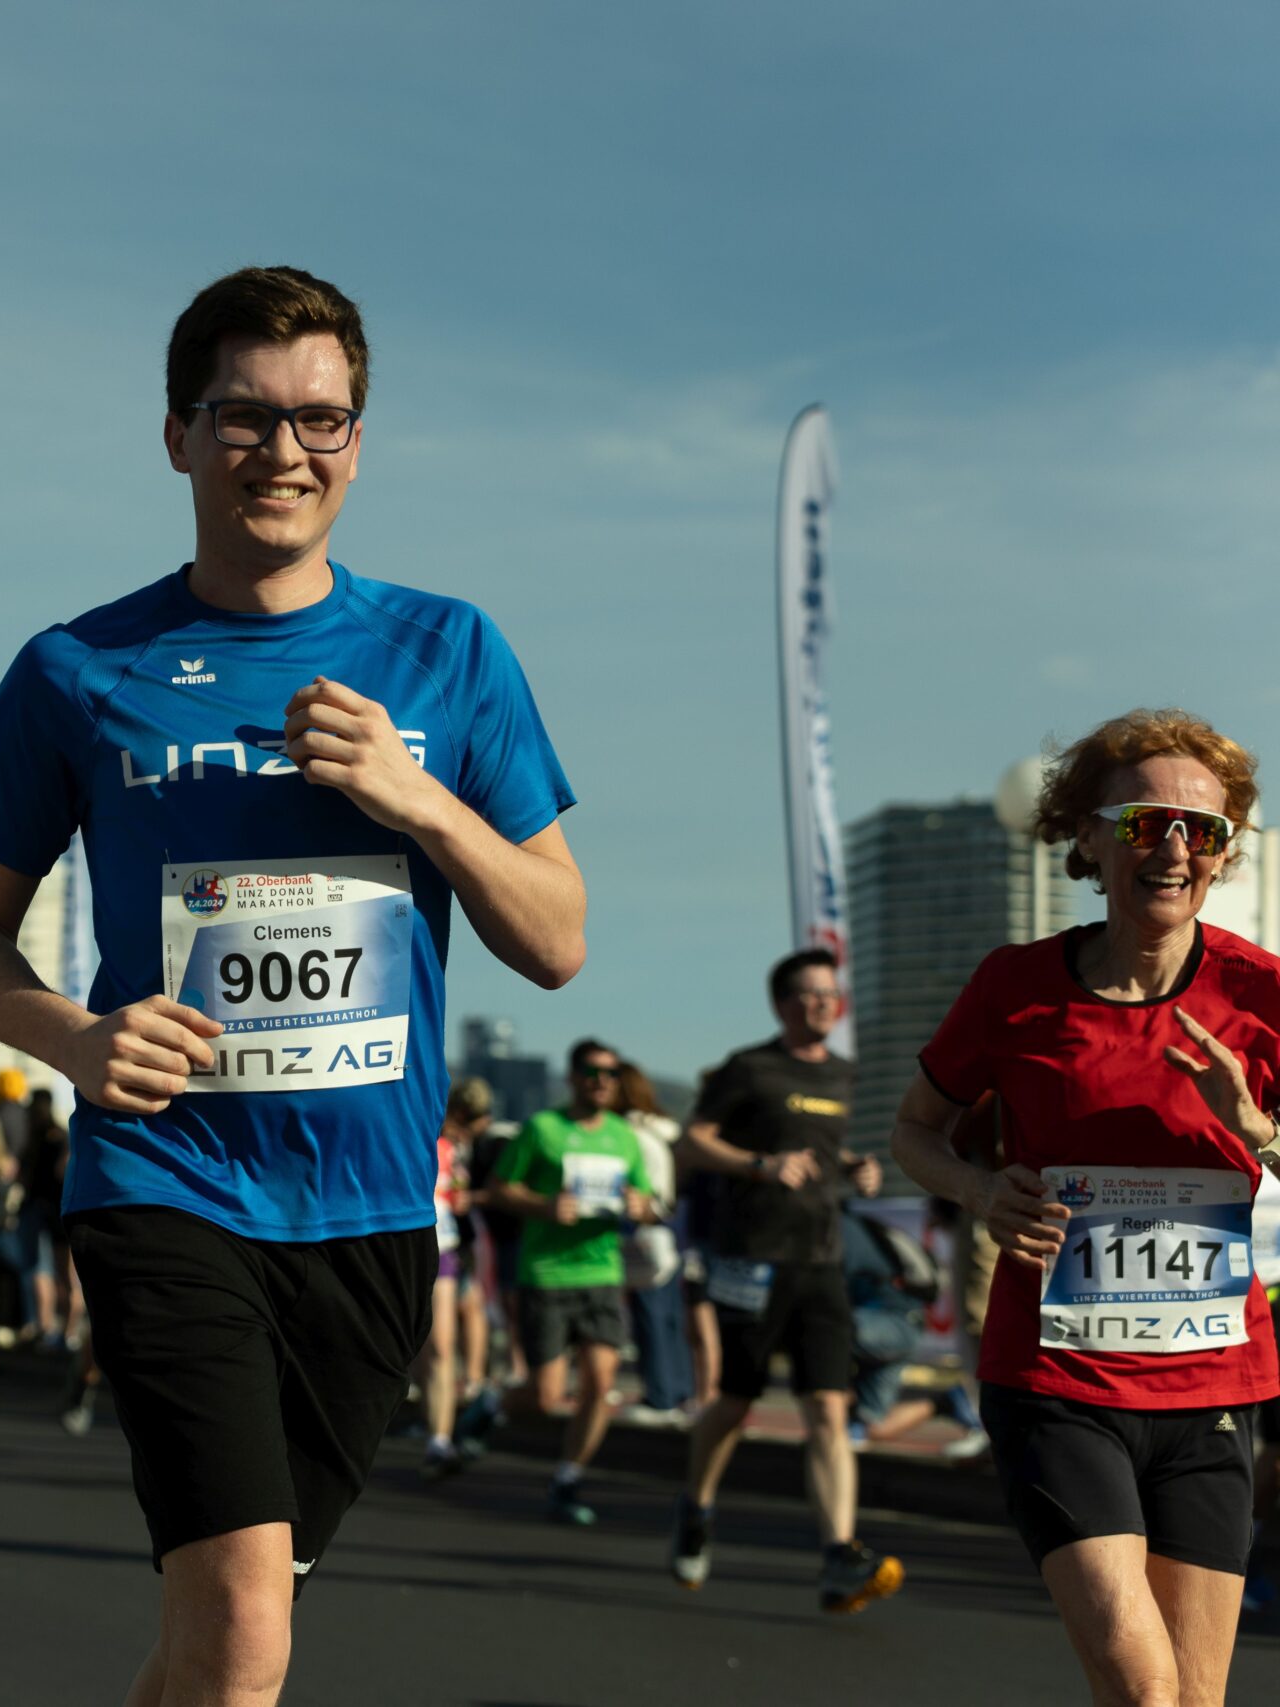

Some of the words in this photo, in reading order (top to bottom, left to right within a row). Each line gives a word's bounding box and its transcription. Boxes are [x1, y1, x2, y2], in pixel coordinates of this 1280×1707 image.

[171, 673, 216, 685] erima
[237, 877, 253, 888] 22.
[256, 873, 313, 887] Oberbank
[237, 889, 263, 898] LINZ
[270, 887, 314, 897] DONAU
[188, 899, 223, 908] 7.4.2024
[238, 898, 314, 909] MARATHON
[254, 926, 332, 941] Clemens
[219, 947, 363, 1005] 9067
[261, 1008, 378, 1028] VIERTELMARATHON
[326, 1040, 393, 1073] AG
[1102, 1179, 1116, 1188] 22.
[1119, 1179, 1165, 1188] Oberbank
[1102, 1189, 1124, 1197] LINZ
[1102, 1197, 1167, 1205] MARATHON
[1122, 1216, 1174, 1232] Regina
[1073, 1238, 1223, 1281] 11147
[1119, 1290, 1220, 1301] VIERTELMARATHON
[1172, 1313, 1231, 1338] AG
